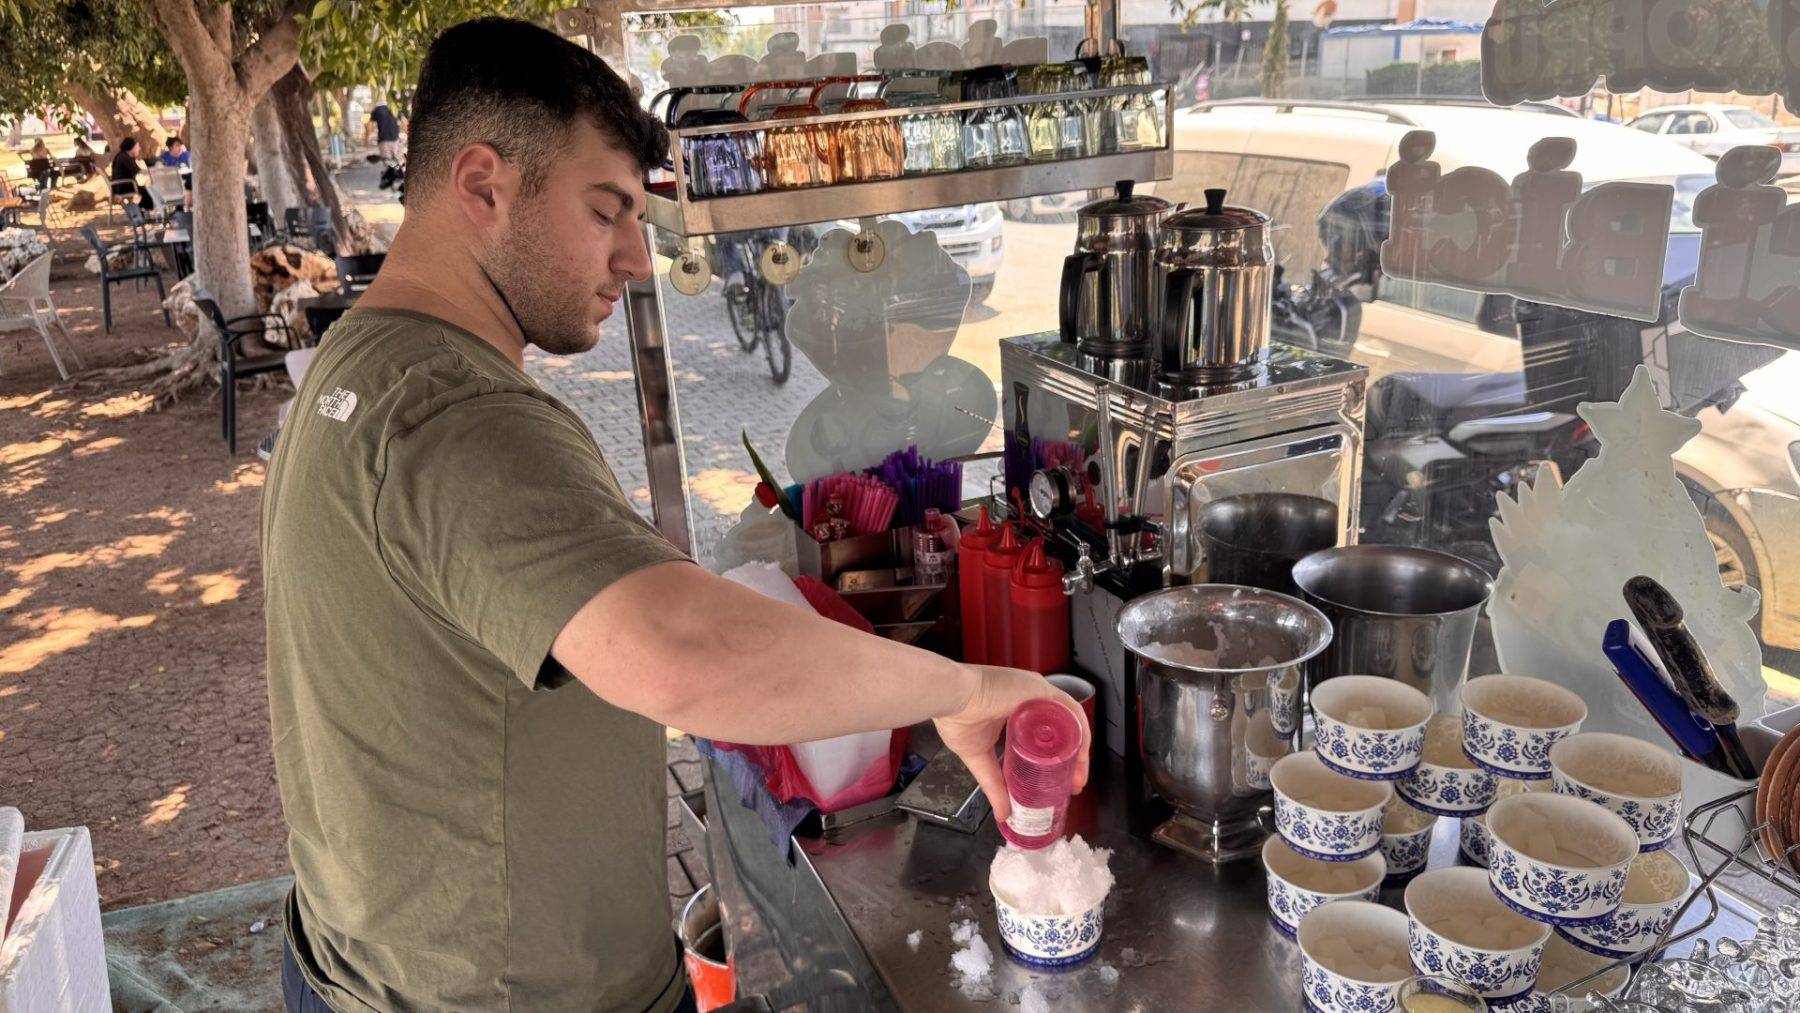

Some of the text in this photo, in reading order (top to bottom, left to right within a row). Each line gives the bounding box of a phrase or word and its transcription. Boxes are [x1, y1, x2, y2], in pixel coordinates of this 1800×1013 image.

[331, 387, 350, 400] THE
[319, 394, 344, 410] NORTH
[317, 404, 340, 418] FACE
